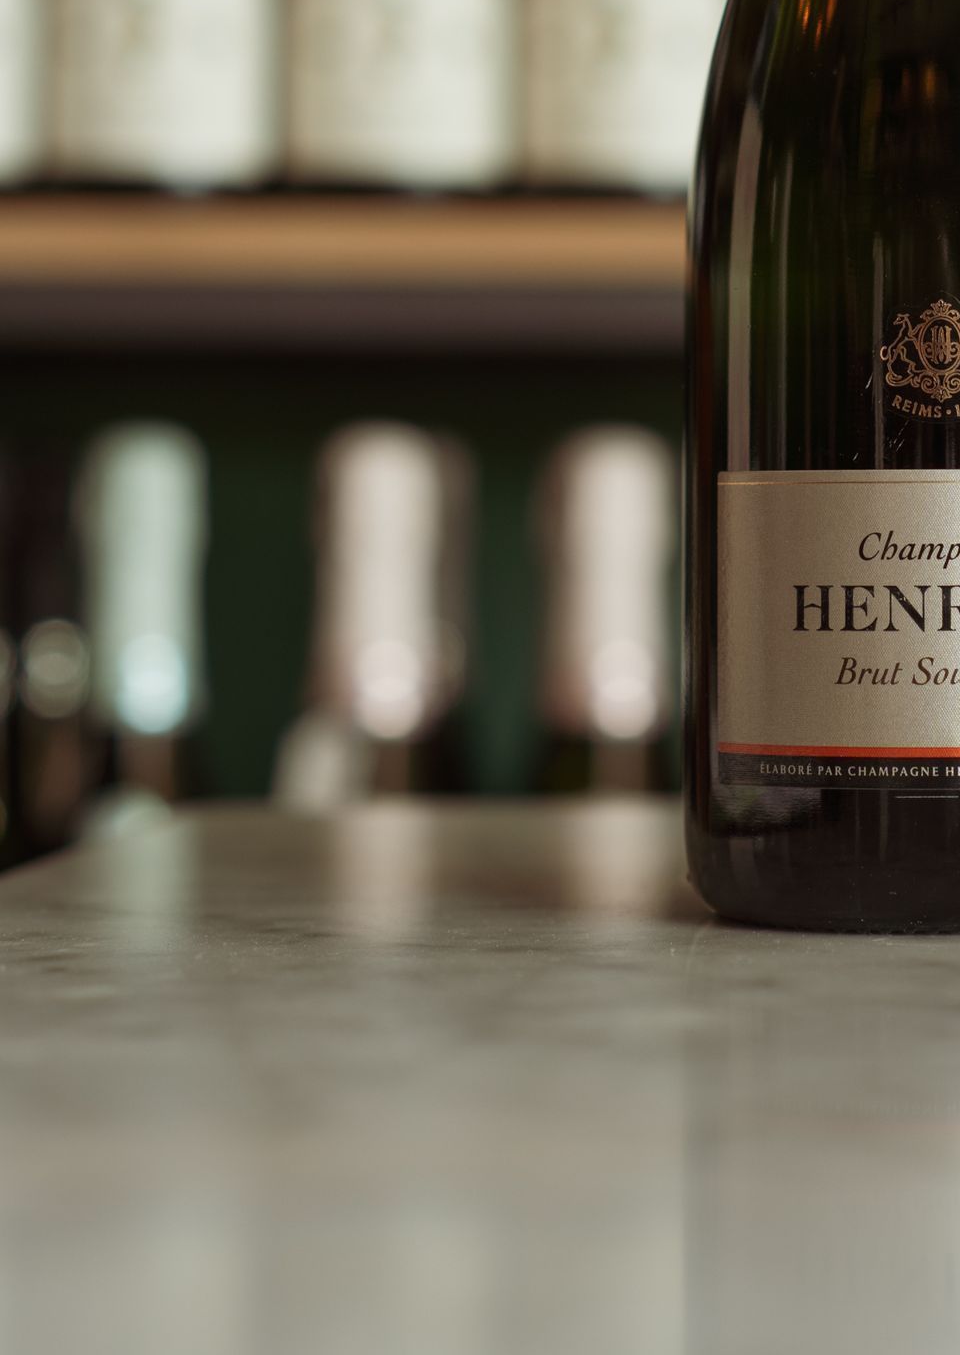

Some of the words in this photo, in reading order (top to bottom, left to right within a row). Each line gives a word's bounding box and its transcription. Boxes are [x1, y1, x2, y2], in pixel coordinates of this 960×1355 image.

[891, 395, 942, 419] REIMS
[834, 656, 903, 686] Brut
[759, 762, 813, 776] ÉLABORÉ
[817, 765, 843, 777] PAR
[847, 765, 940, 778] CHAMPAGNE
